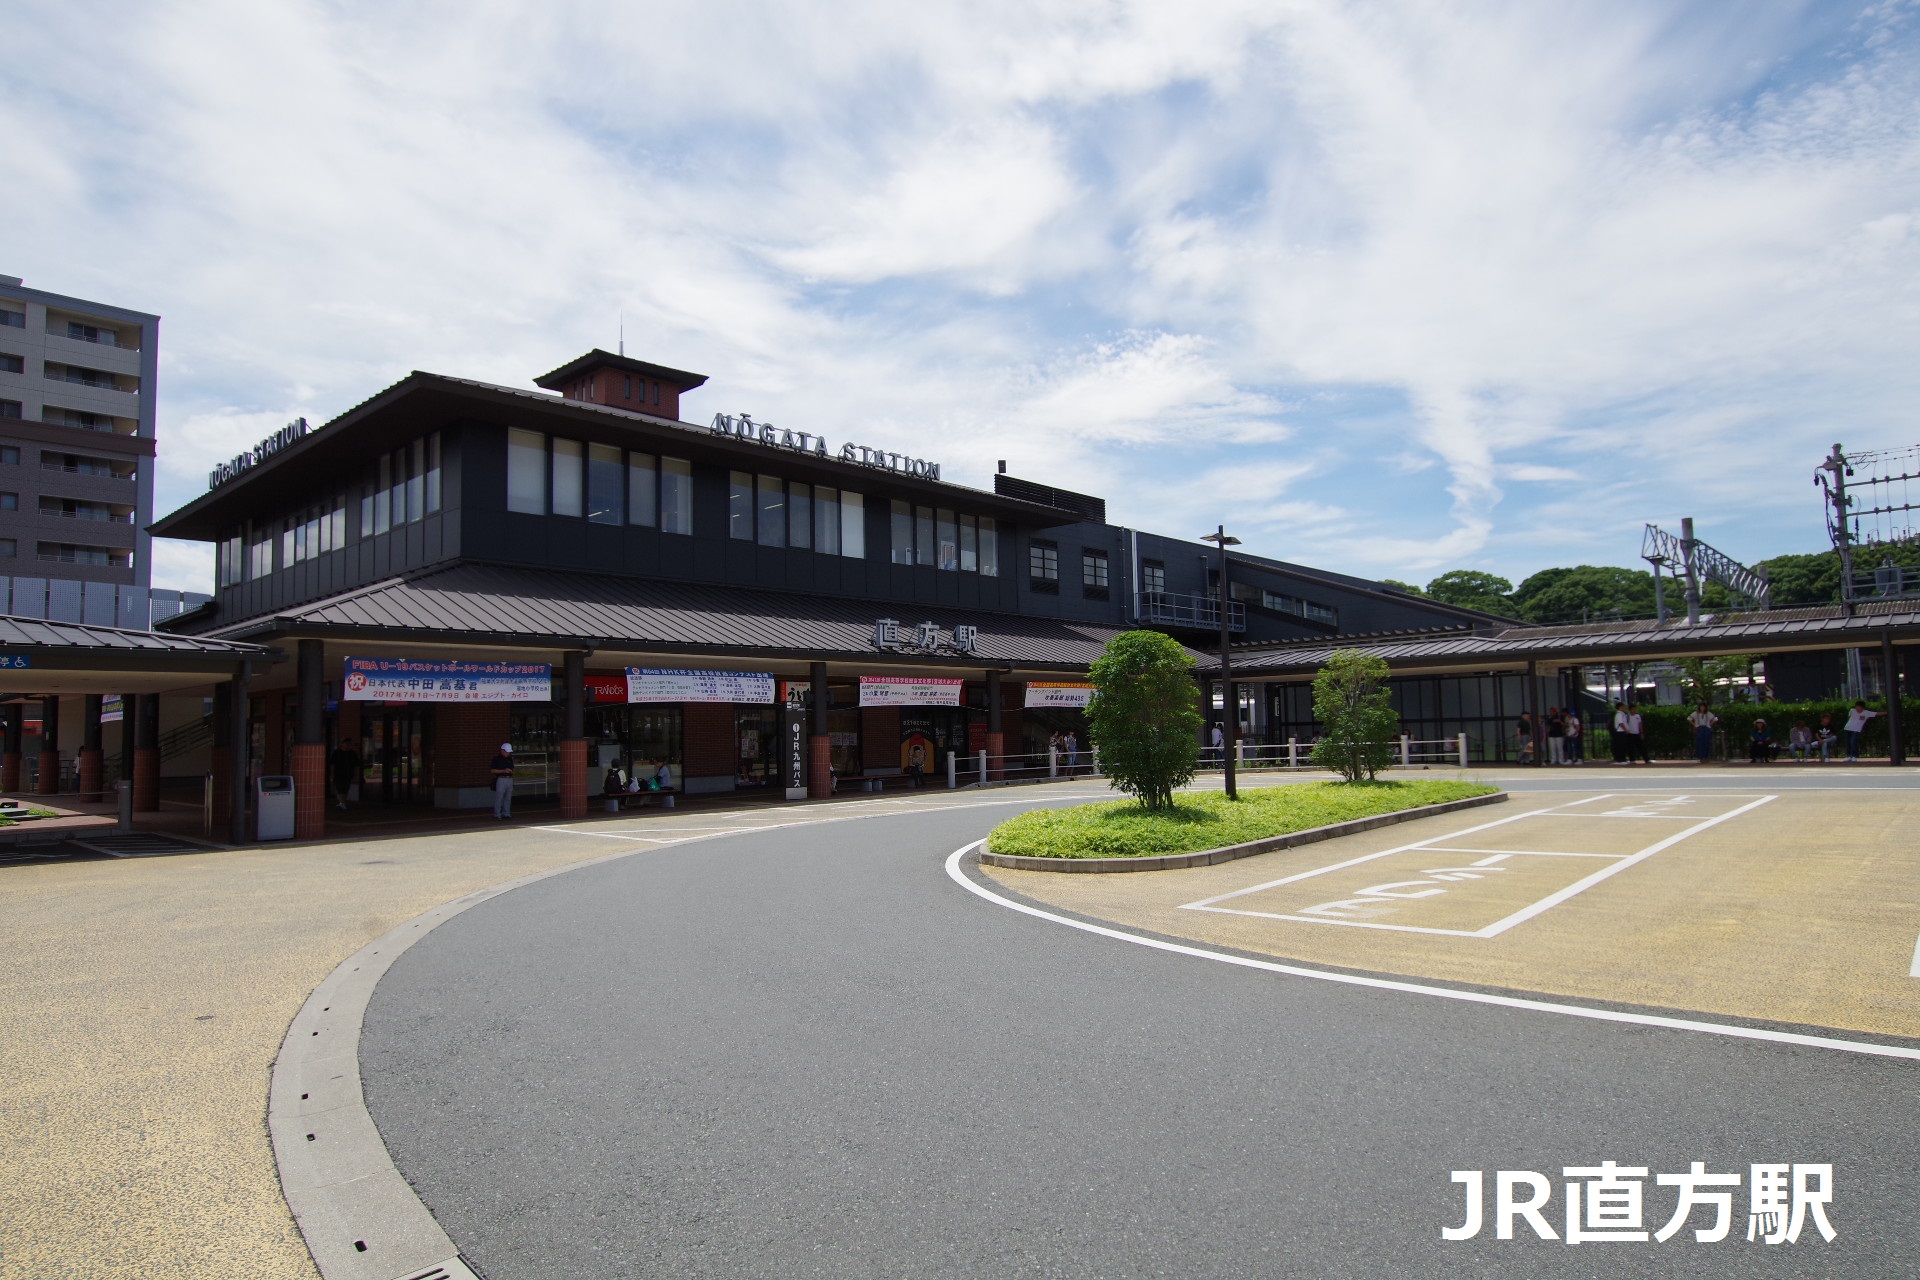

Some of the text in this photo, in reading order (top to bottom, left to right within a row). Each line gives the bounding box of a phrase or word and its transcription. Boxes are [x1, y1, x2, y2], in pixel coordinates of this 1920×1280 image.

[253, 417, 306, 463] STATION
[715, 412, 941, 481] NŌGATA STATION
[876, 618, 978, 652] 直方駅
[352, 660, 378, 671] FIBA
